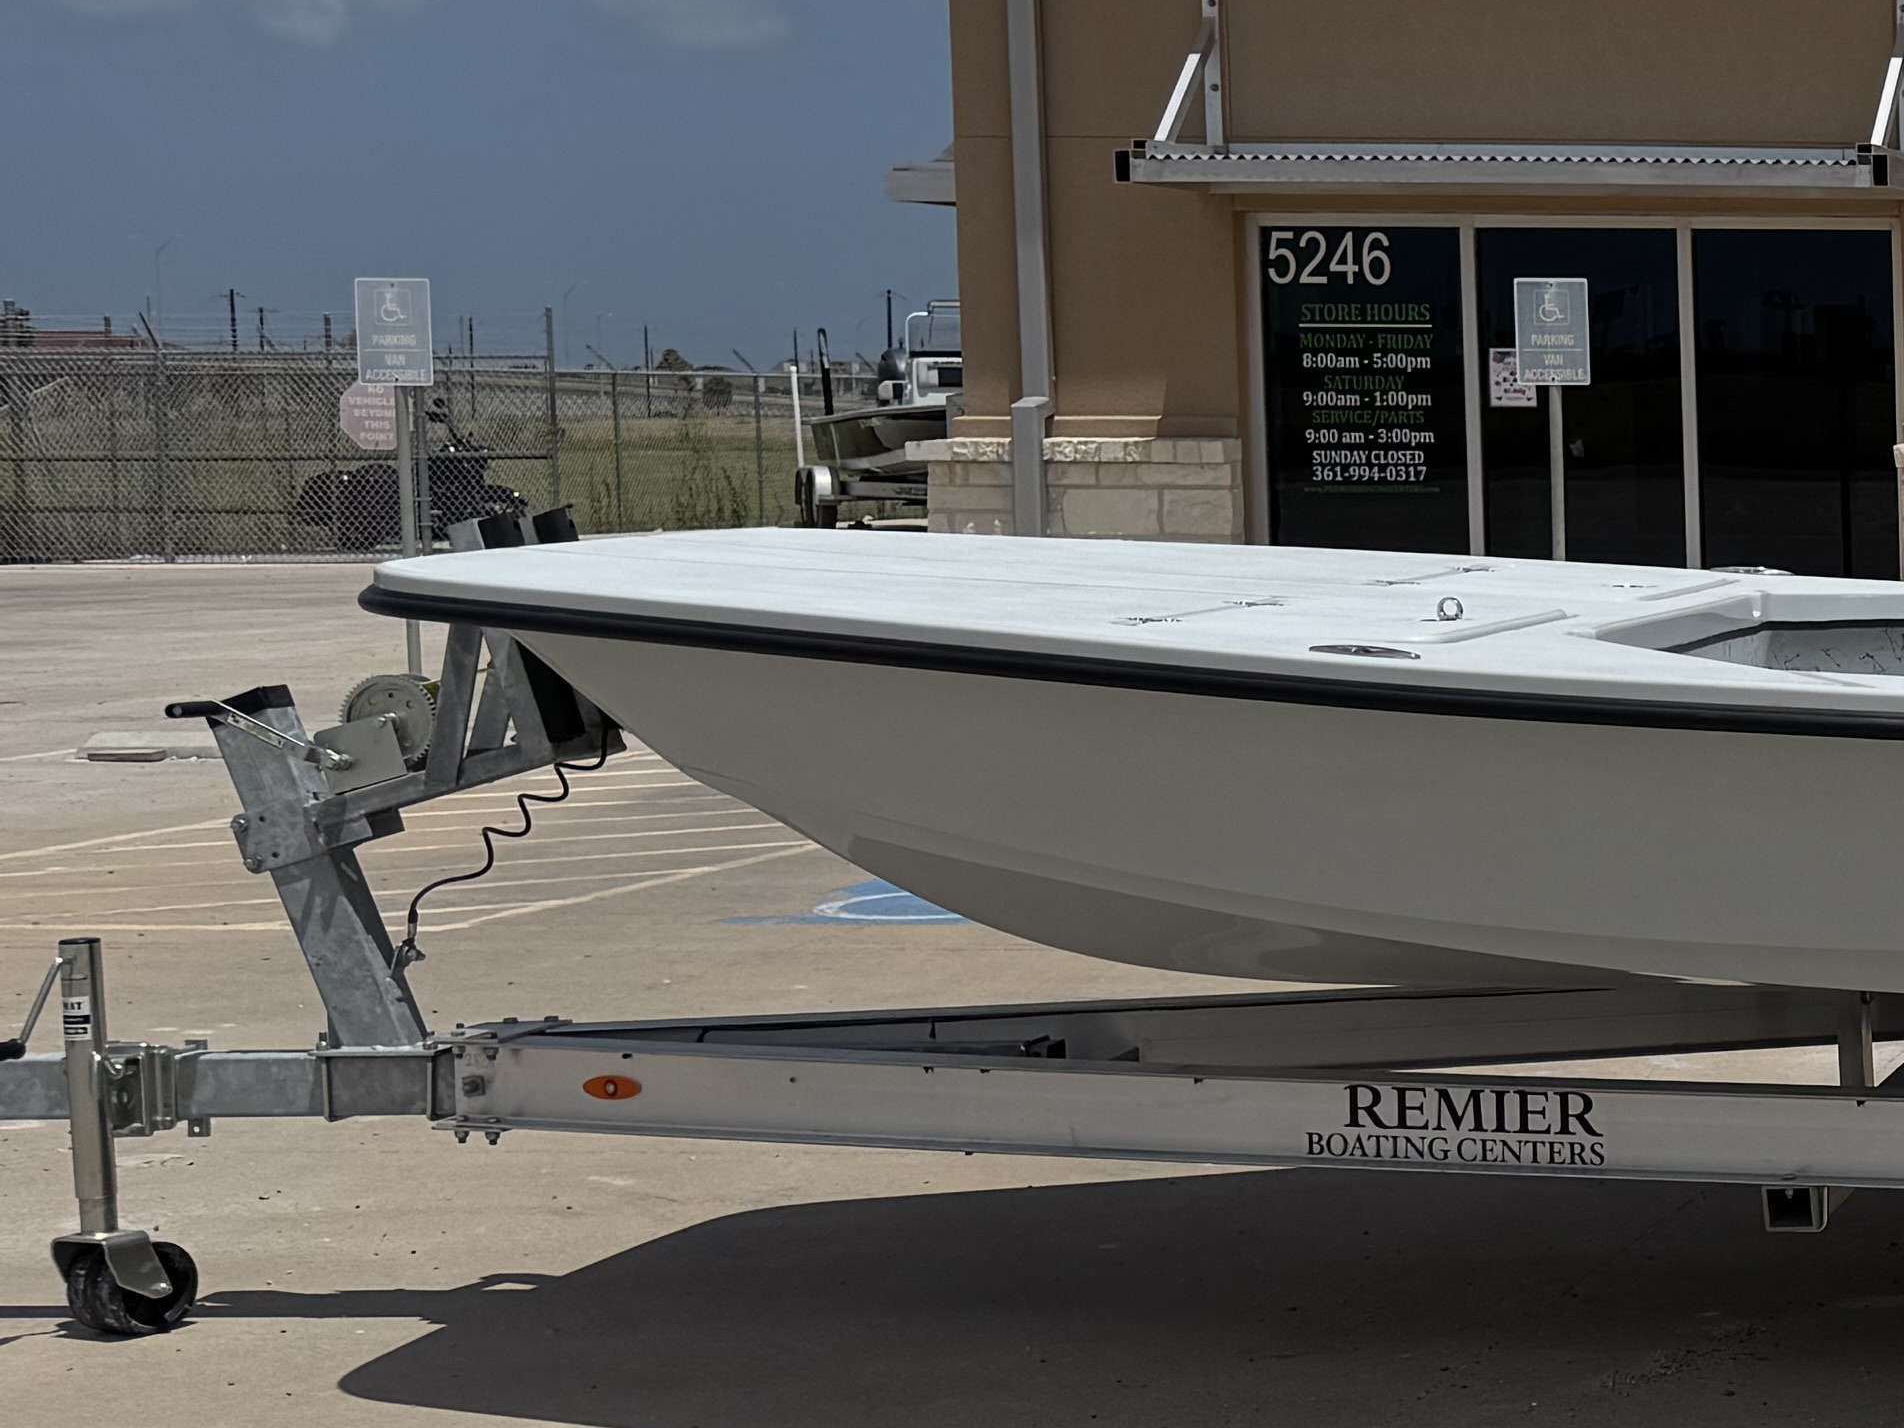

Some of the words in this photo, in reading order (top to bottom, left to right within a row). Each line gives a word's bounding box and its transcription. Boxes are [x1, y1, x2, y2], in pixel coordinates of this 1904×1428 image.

[1267, 231, 1392, 285] 5246
[1301, 303, 1362, 321] STORE
[1366, 303, 1430, 321] HOURS
[1299, 333, 1365, 349] MONDAY
[1377, 333, 1434, 349] FRIDAY
[1531, 334, 1575, 347] PARKING
[1302, 353, 1360, 369] 8:00am
[1372, 353, 1431, 373] 5:00pm
[1323, 375, 1405, 390] SATURDAY
[1302, 391, 1361, 406] 9:00am
[1373, 391, 1432, 410] 1:00pm
[1312, 410, 1425, 427] SERVICE/PARTS
[1305, 429, 1338, 444] 9:00
[1341, 431, 1365, 444] am
[1377, 428, 1435, 446] 3:00pm
[1312, 450, 1368, 464] SUNDAY
[1370, 450, 1425, 464] CLOSED
[1312, 465, 1427, 481] 361-994-0317
[1344, 1084, 1604, 1138] REMIER
[1305, 1131, 1451, 1162] BOATING
[1457, 1137, 1606, 1167] CENTERS
